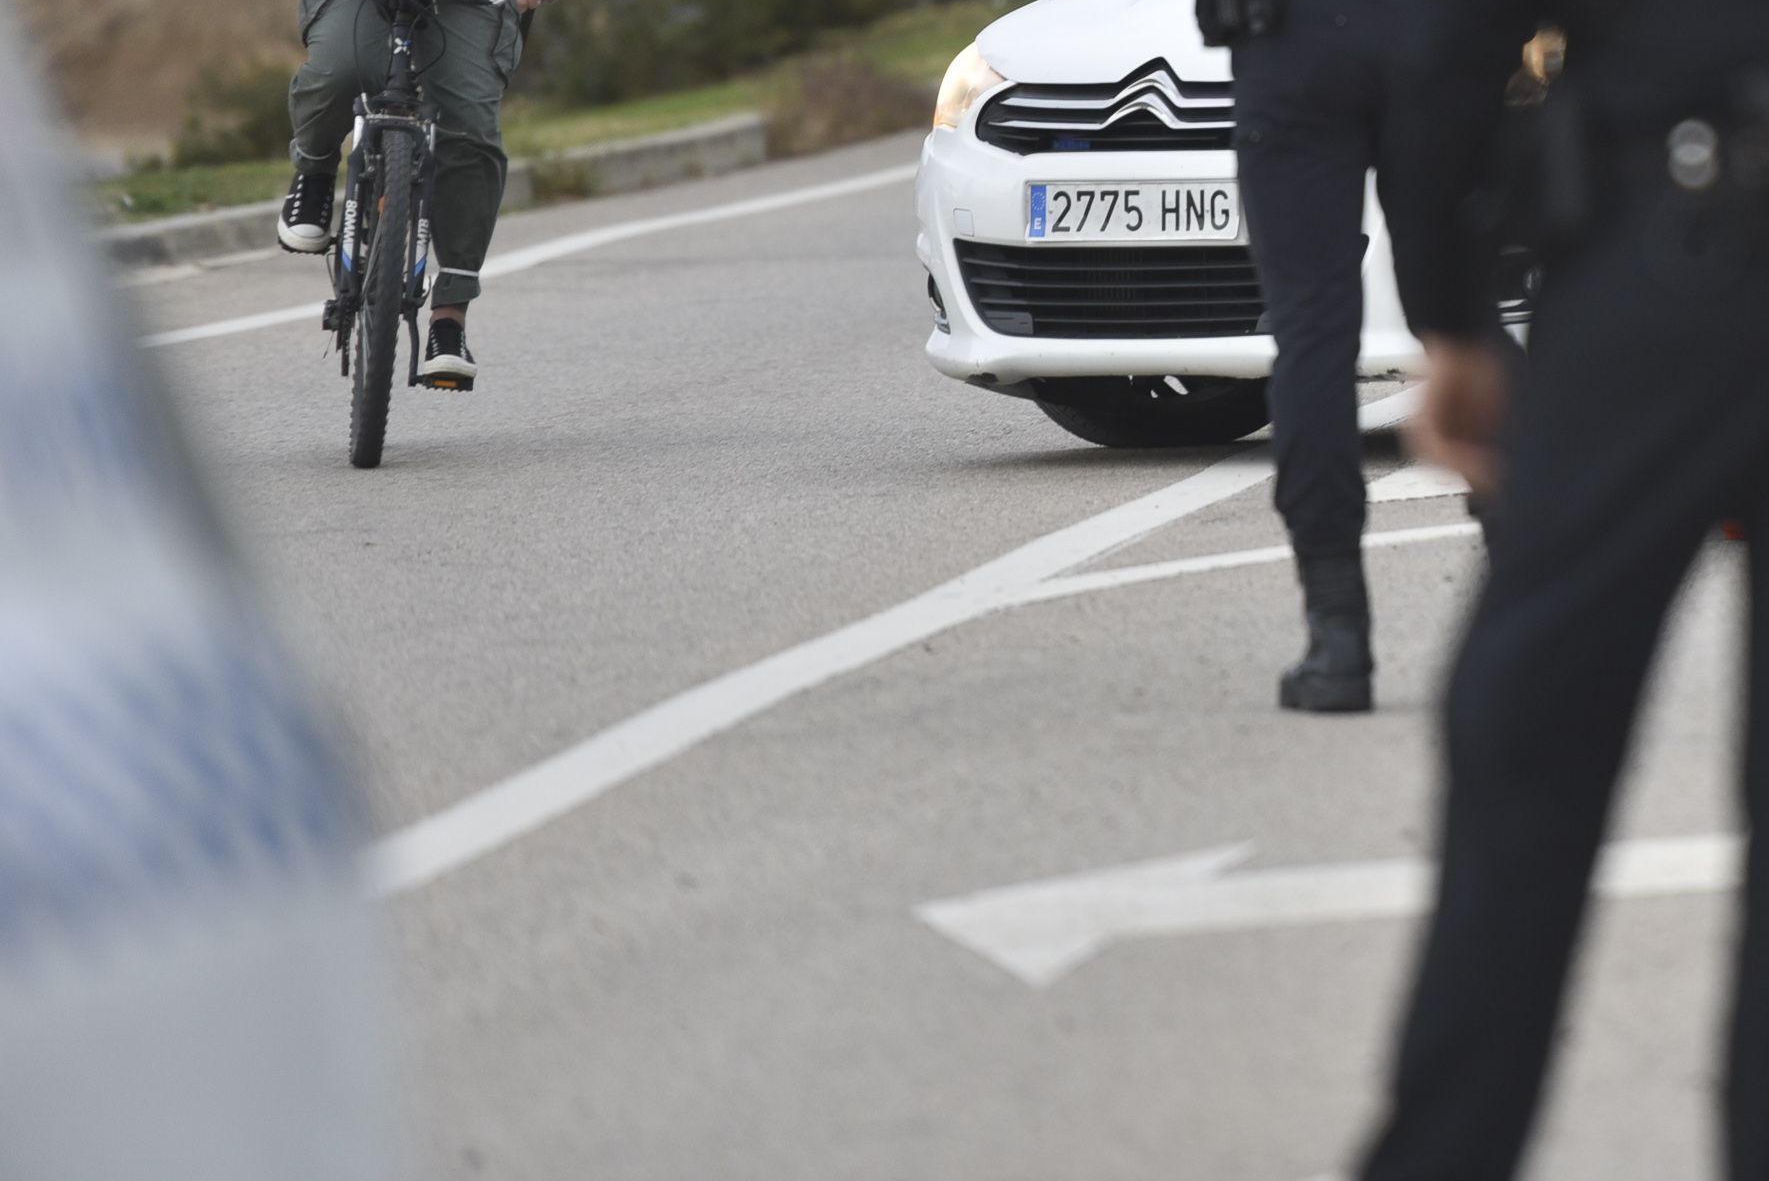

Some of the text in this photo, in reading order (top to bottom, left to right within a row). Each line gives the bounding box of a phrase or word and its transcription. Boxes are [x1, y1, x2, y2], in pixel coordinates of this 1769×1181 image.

[1033, 217, 1042, 231] E
[1051, 189, 1230, 233] 2775 HNG
